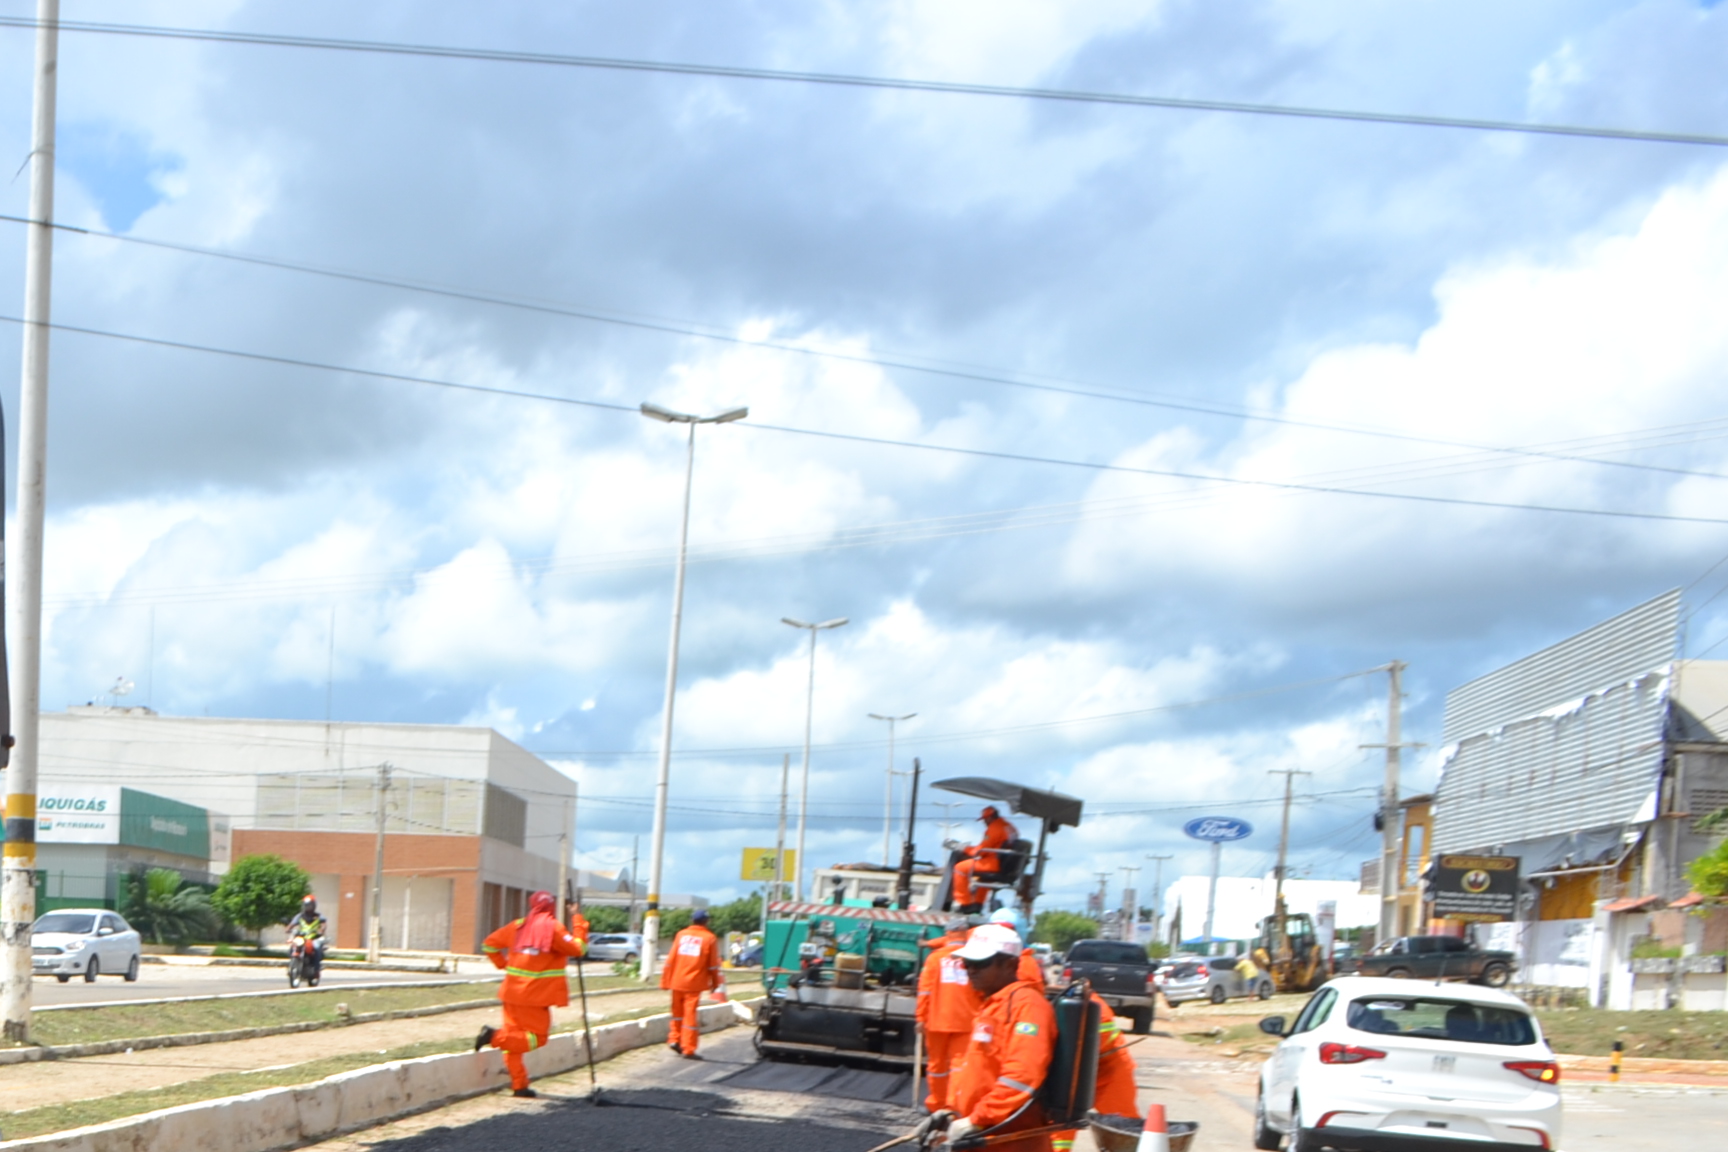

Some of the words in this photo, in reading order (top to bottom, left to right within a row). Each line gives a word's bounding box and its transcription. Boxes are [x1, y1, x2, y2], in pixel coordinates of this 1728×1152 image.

[38, 796, 107, 812] IQUIGÁS
[55, 821, 106, 830] PETROBRAS
[1195, 819, 1241, 838] Ford
